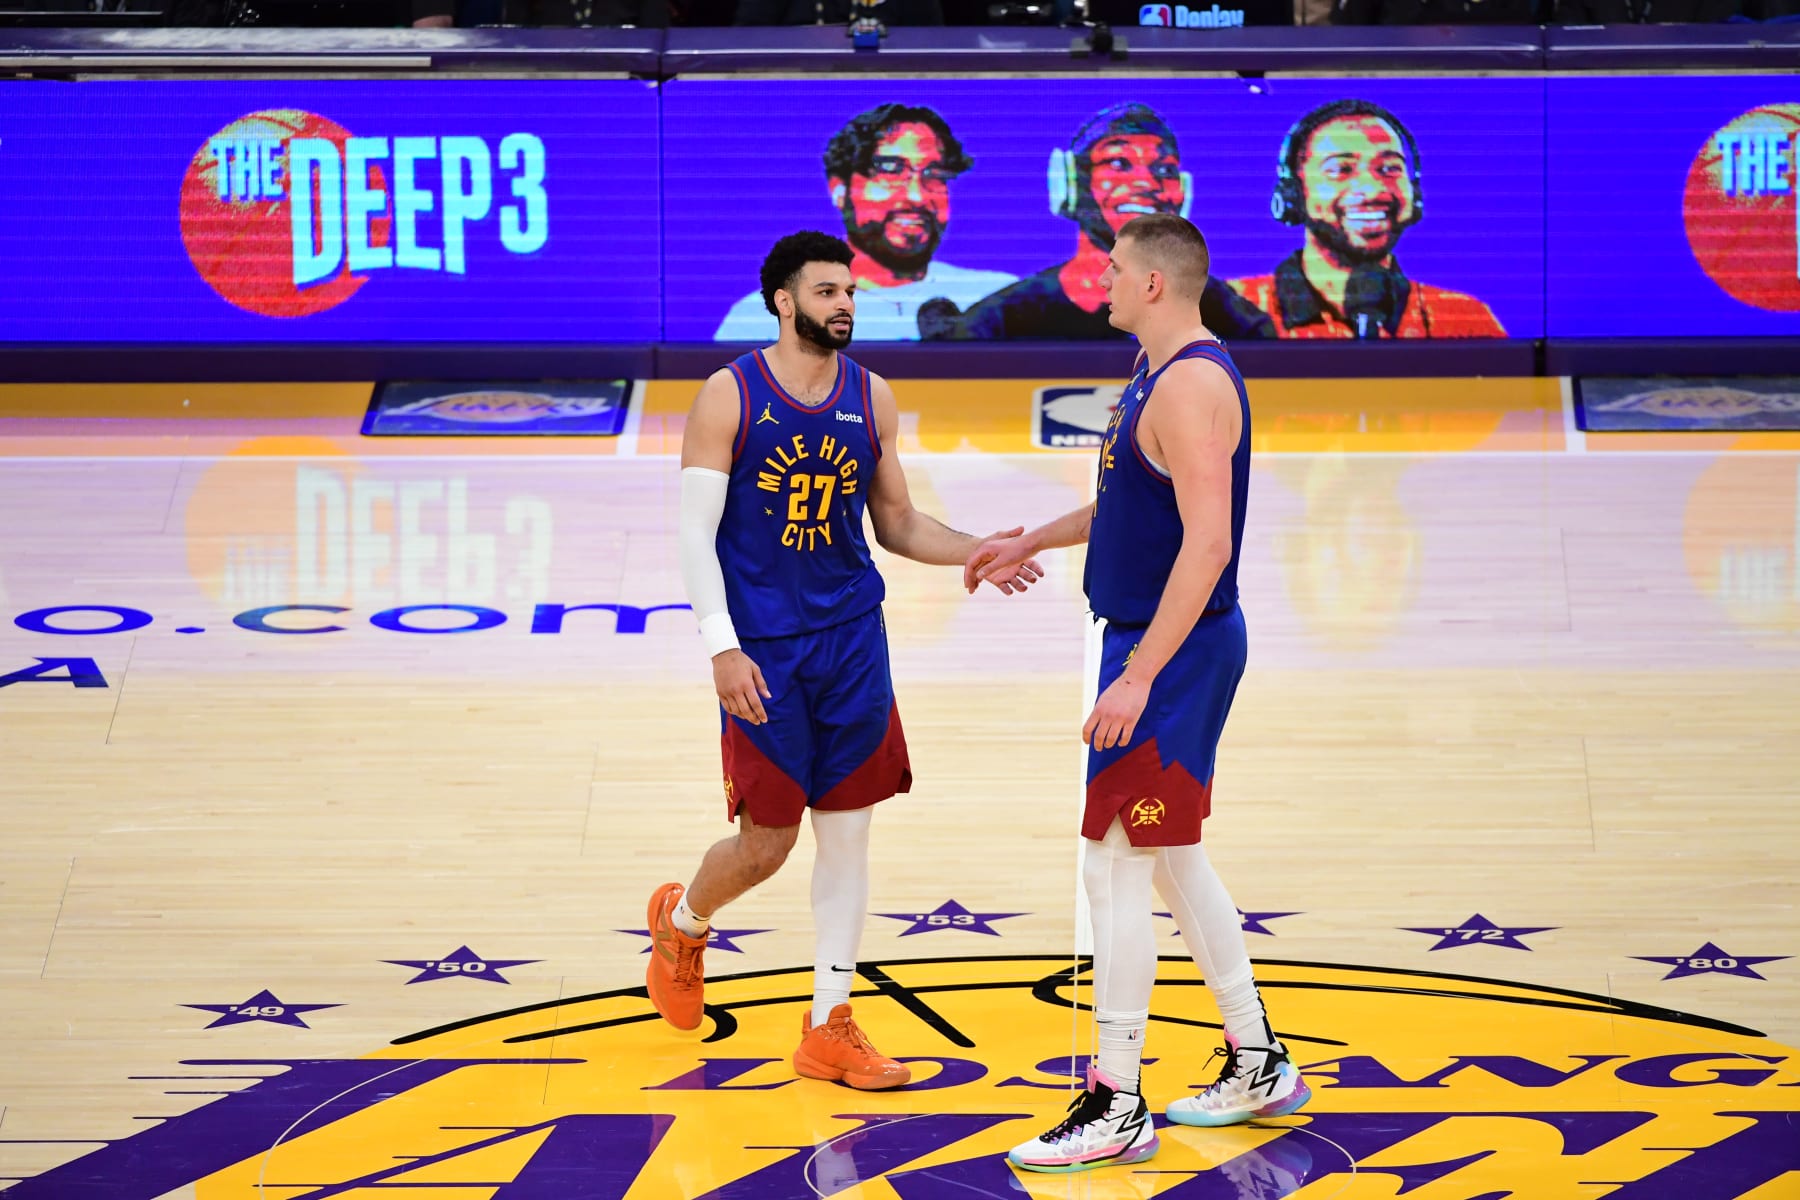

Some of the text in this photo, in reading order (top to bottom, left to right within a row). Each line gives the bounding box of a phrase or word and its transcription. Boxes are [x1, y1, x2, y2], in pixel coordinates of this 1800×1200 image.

[1715, 132, 1791, 191] THE
[209, 132, 548, 285] THE DEEP 3
[835, 410, 863, 424] ibotta
[1051, 434, 1101, 447] NB
[756, 434, 858, 495] MILE HIGH
[787, 473, 837, 521] 27
[781, 522, 832, 552] CITY
[915, 914, 976, 926] '53
[1444, 928, 1505, 940] '72
[425, 961, 487, 973] '50
[1676, 957, 1738, 969] '80
[228, 1006, 285, 1017] '49
